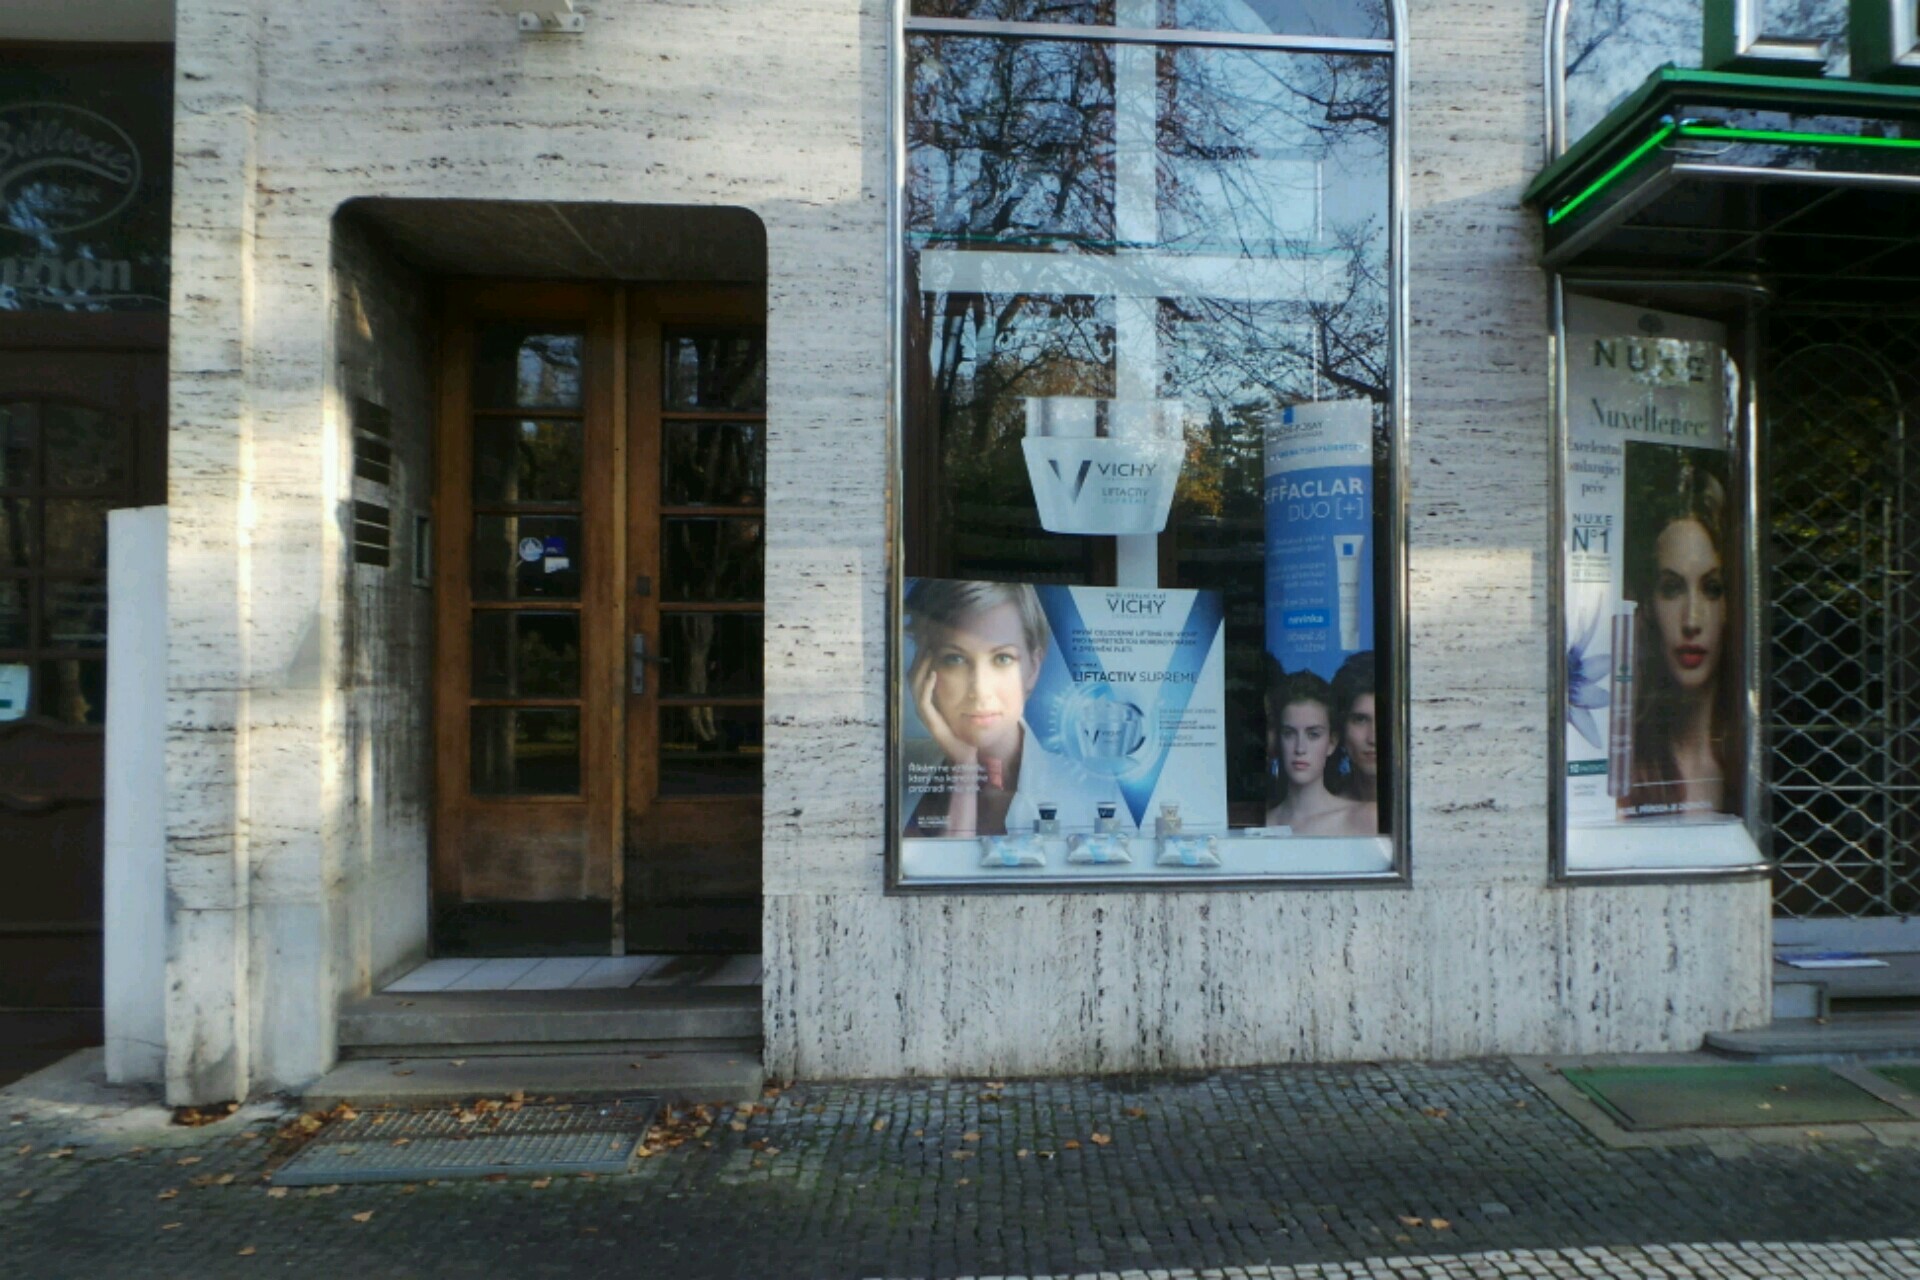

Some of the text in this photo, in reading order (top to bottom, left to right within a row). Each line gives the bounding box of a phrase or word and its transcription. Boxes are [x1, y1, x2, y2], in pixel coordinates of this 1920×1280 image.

[1593, 340, 1705, 381] NUXE
[1098, 463, 1157, 477] VICHY
[1288, 502, 1330, 522] DUO
[1572, 512, 1614, 526] NUXE
[1107, 599, 1166, 614] VICHY
[1072, 671, 1198, 684] LIFTACTIV SUPREME
